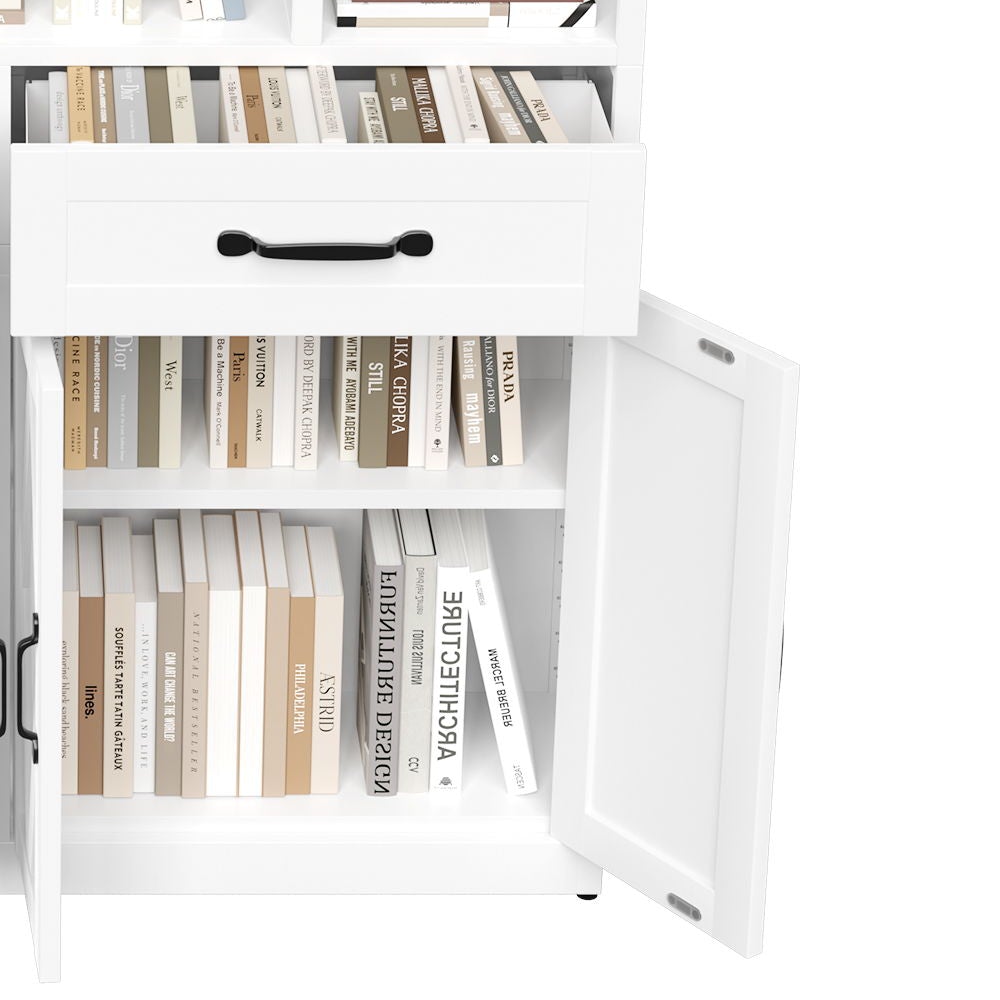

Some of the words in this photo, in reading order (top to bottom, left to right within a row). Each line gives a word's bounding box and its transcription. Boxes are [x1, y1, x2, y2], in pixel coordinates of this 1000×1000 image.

[390, 97, 409, 112] STILL
[531, 98, 551, 121] PRADA
[164, 360, 177, 391] West
[232, 352, 245, 382] Paris
[256, 344, 265, 388] VUITTON
[368, 362, 384, 394] STILL
[502, 351, 514, 402] PRADA
[392, 376, 407, 434] CHOPRA
[467, 392, 483, 444] mayhem
[114, 627, 124, 670] SOUFFLÉS
[85, 685, 97, 719] lines.
[114, 673, 123, 699] TARTE
[293, 663, 306, 734] PHILADELPHIA
[114, 701, 123, 727] TATIN
